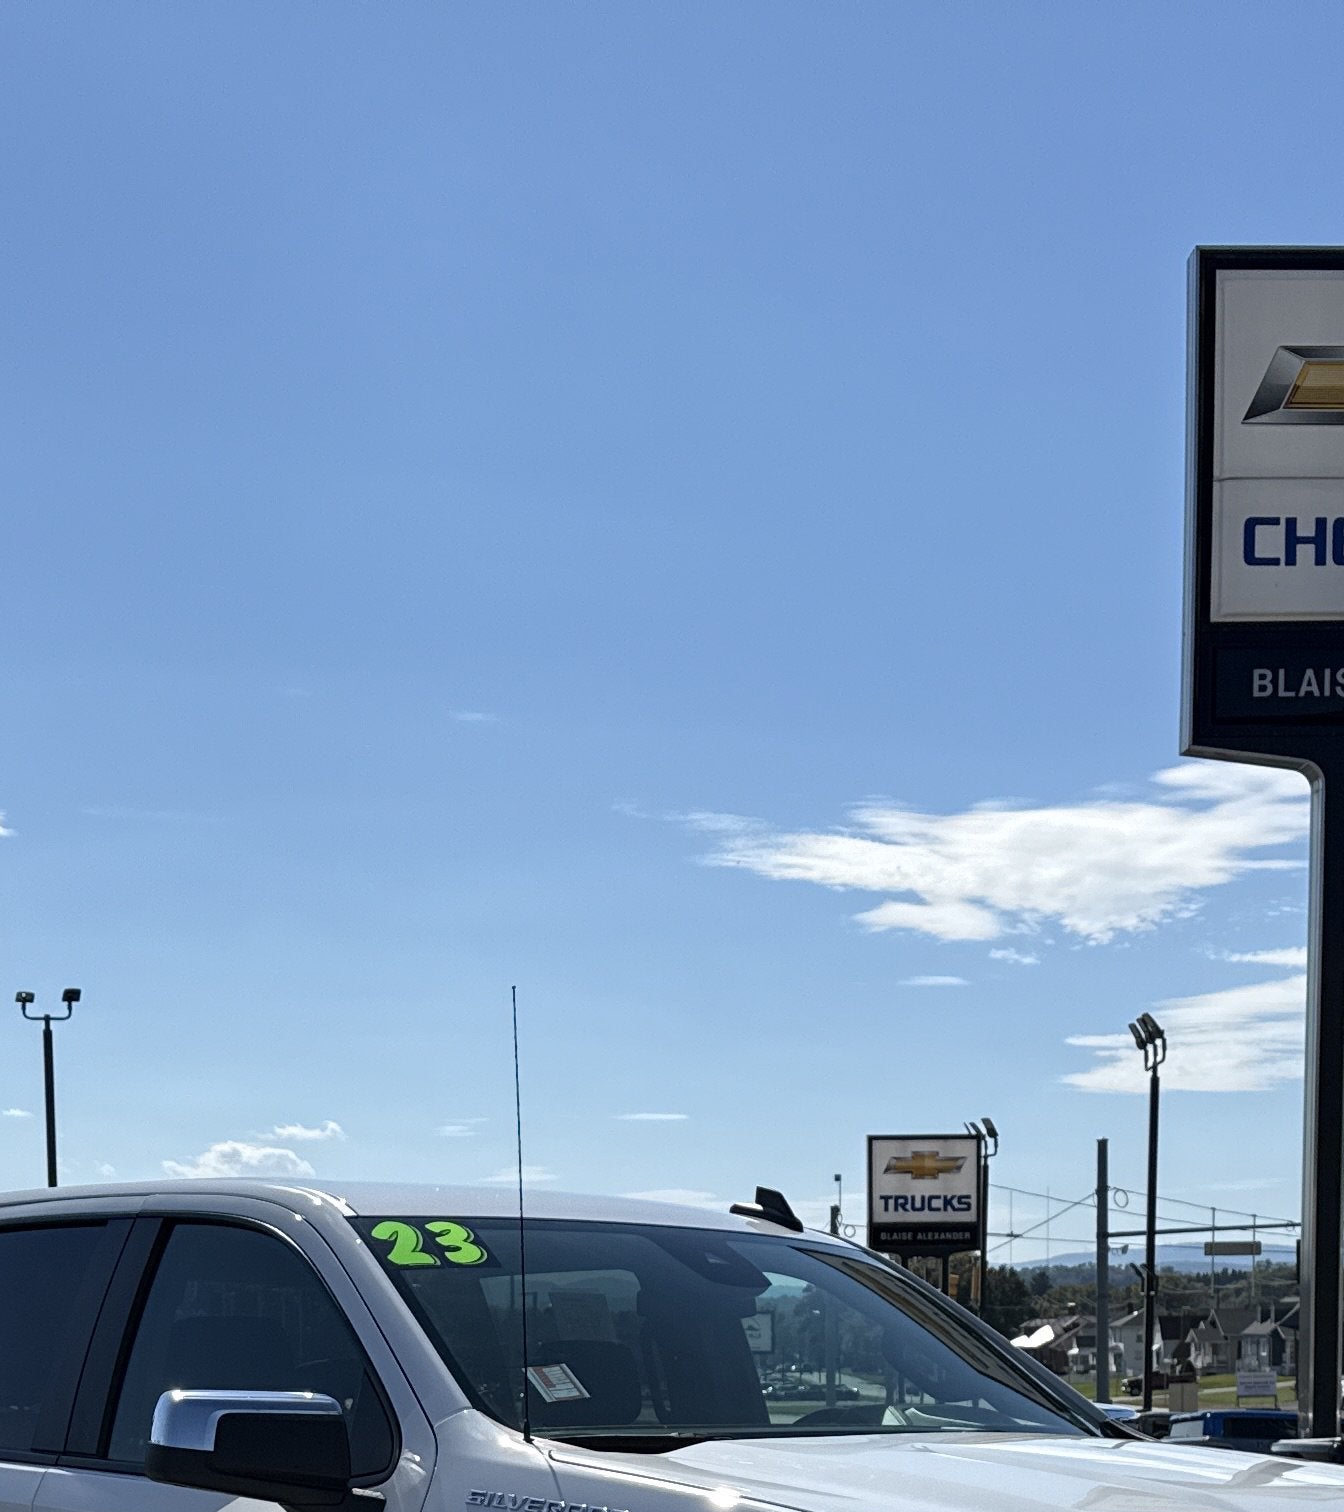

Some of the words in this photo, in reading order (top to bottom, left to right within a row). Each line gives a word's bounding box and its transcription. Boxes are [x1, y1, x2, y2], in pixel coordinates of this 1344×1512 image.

[879, 1194, 972, 1213] TRUCKS
[371, 1221, 488, 1266] 23
[880, 1231, 914, 1241] BLAISE
[917, 1231, 971, 1241] ALEXANDER
